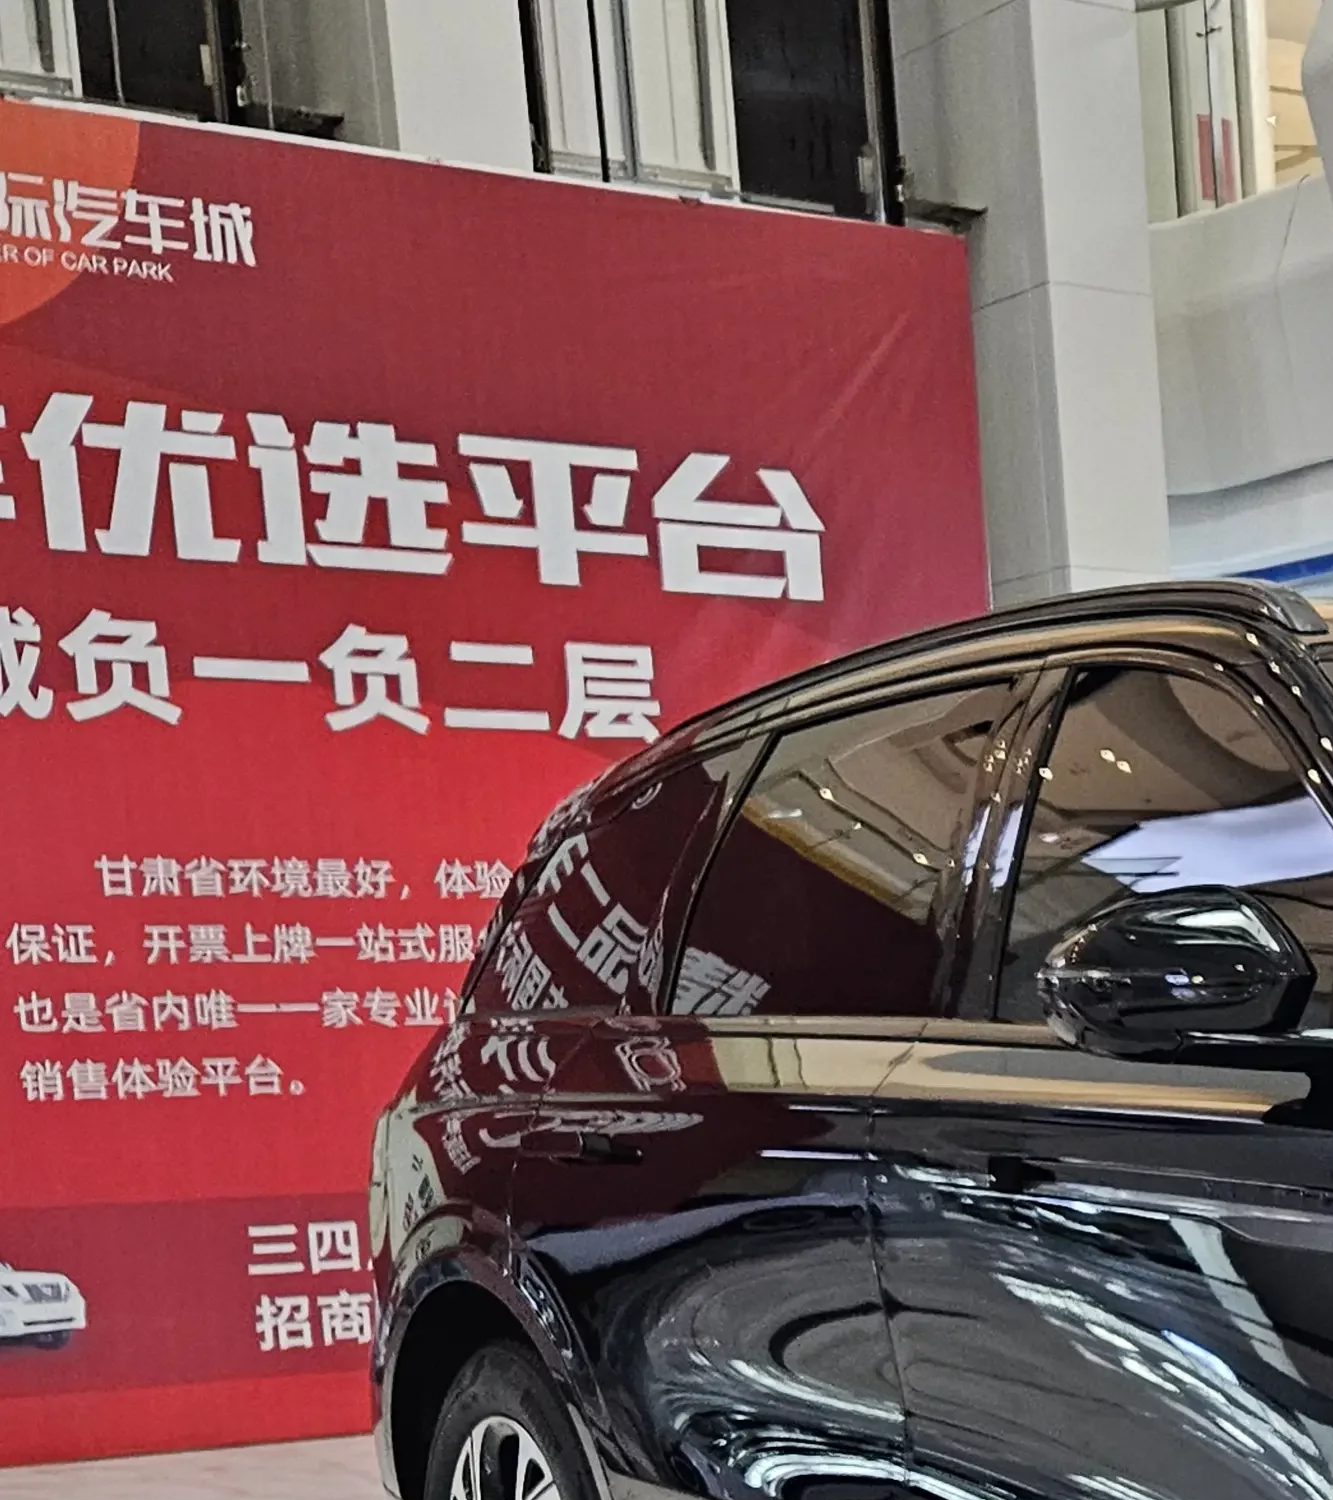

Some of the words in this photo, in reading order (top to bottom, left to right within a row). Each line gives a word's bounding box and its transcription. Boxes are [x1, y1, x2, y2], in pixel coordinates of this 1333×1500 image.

[24, 247, 54, 266] OF
[61, 251, 108, 275] CAR
[112, 258, 174, 283] PARK
[0, 391, 826, 602] 优选平台
[6, 921, 489, 966] 保证，开票上牌一站式服
[20, 1055, 306, 1102] 销售体验平台。
[255, 1288, 373, 1352] 招商
